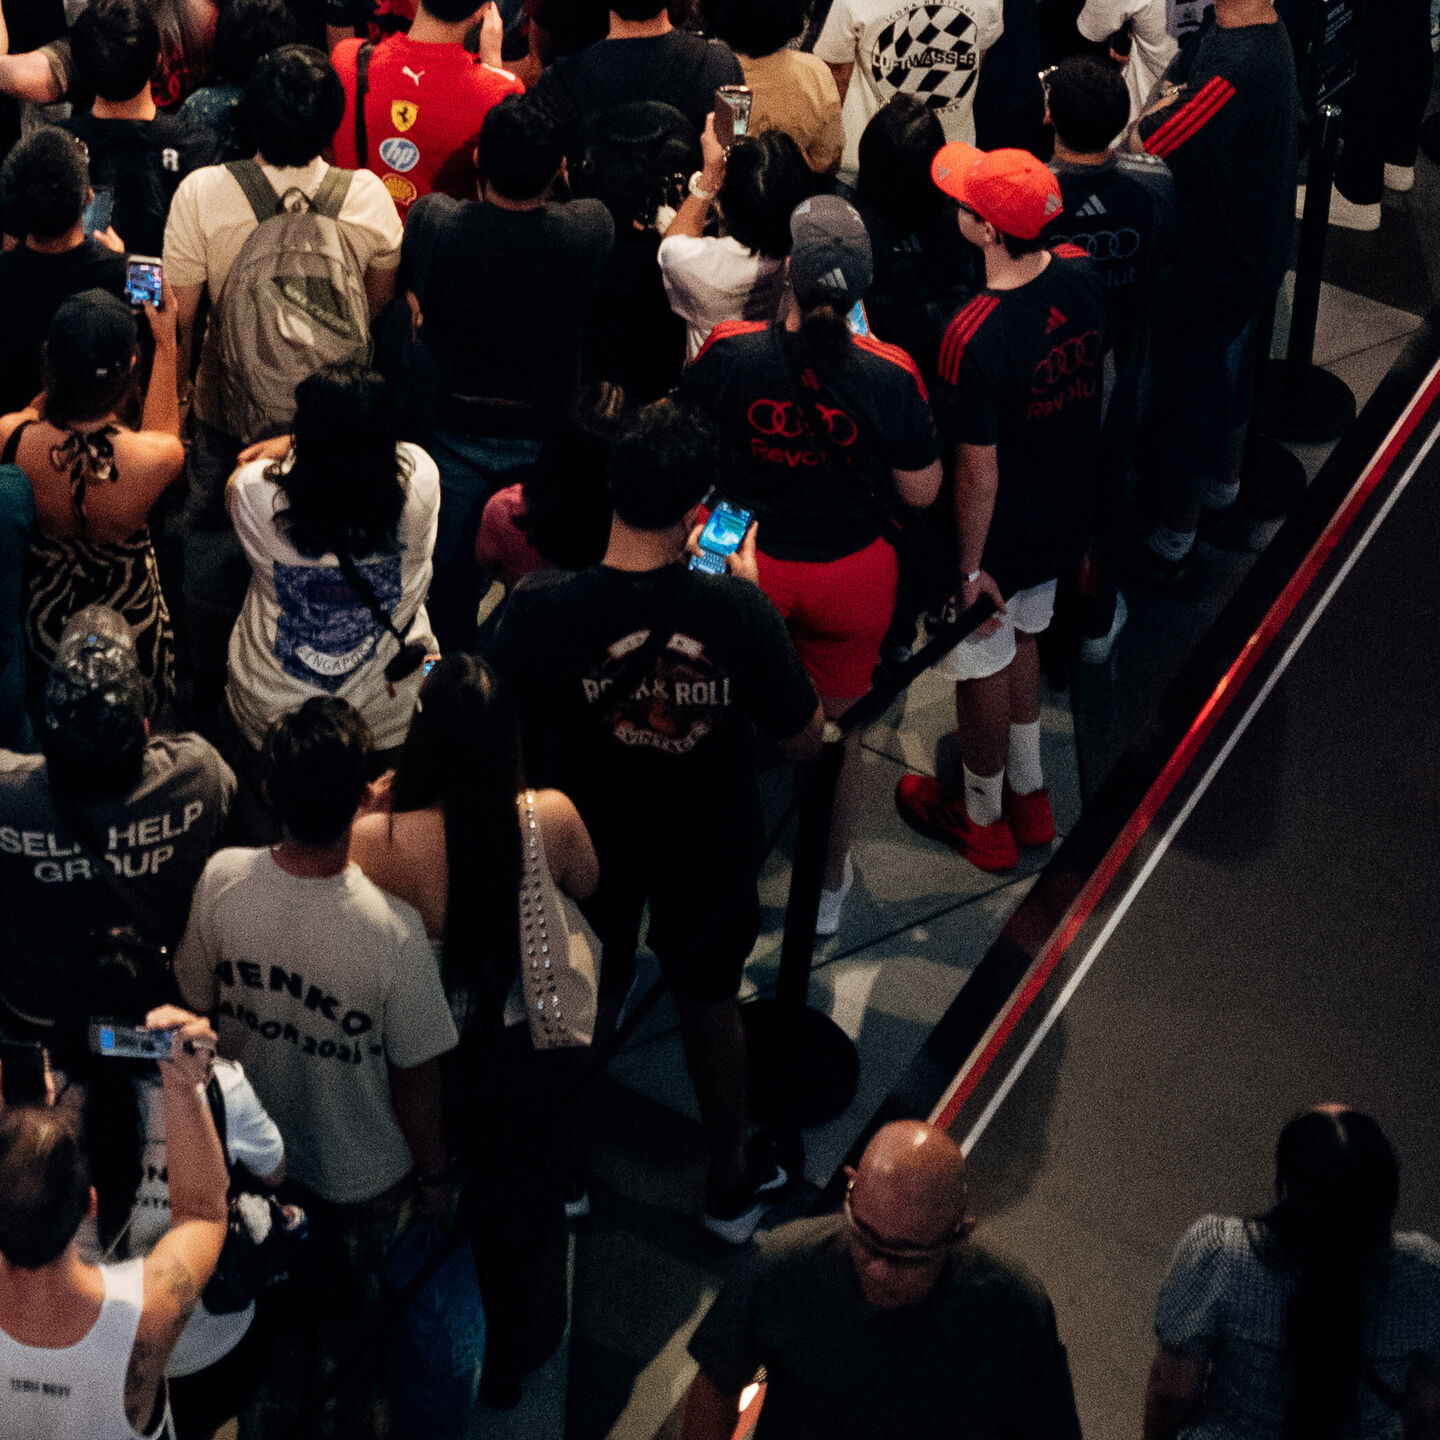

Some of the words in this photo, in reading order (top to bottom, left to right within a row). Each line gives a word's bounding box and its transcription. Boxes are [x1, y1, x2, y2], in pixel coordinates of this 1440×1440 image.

[161, 148, 178, 171] R
[384, 138, 417, 171] hp
[107, 800, 204, 851] HELP
